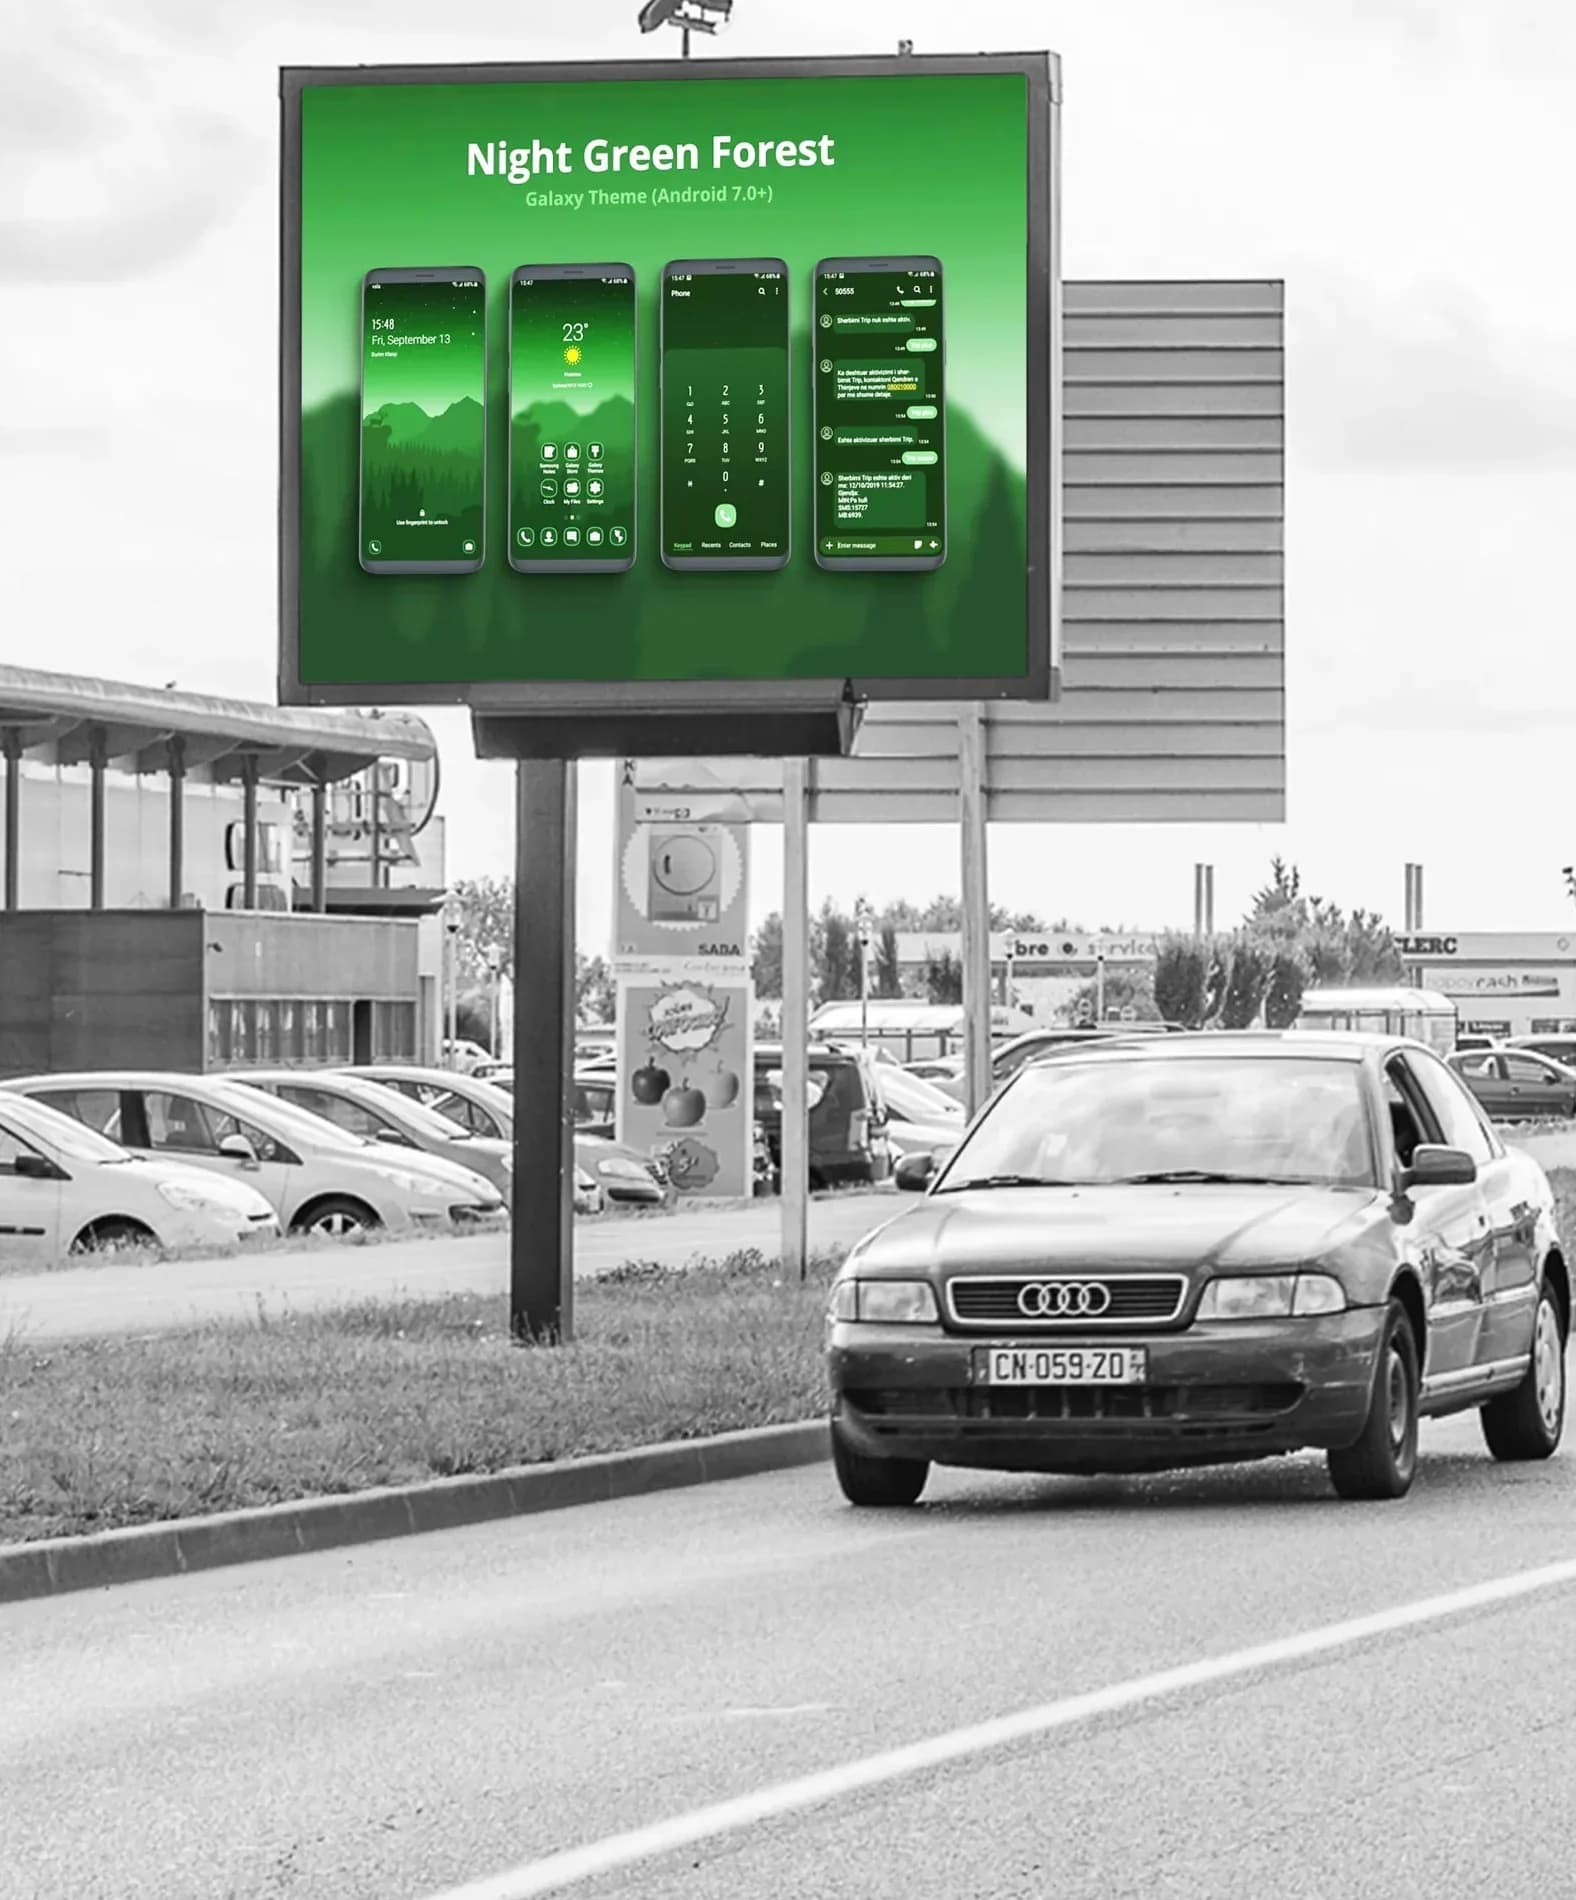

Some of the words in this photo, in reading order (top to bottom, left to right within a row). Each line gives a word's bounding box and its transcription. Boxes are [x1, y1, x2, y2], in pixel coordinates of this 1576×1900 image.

[467, 139, 572, 185] Night
[583, 138, 699, 173] Green
[712, 134, 835, 169] Forest
[525, 190, 584, 211] Galaxy
[588, 187, 648, 206] Theme
[651, 184, 728, 207] (Android
[731, 184, 774, 204] 7.0+)
[670, 289, 691, 298] Phone
[834, 287, 855, 296] 50555
[370, 318, 395, 331] 15:48
[861, 316, 871, 324] Trip
[561, 322, 589, 342] 23°
[371, 335, 386, 347] Fri,
[387, 334, 437, 348] September
[439, 333, 451, 345] 13
[687, 385, 693, 397] 1
[722, 384, 729, 397] 2
[758, 383, 765, 396] 3
[687, 413, 694, 426] 4
[722, 413, 729, 425] 5
[758, 412, 765, 425] 6
[687, 442, 694, 455] 7
[722, 442, 729, 454] 8
[758, 441, 765, 453] 9
[722, 471, 729, 483] 0
[862, 474, 872, 482] Trip
[849, 481, 880, 489] 12/10/2019
[395, 519, 405, 527] Use
[701, 541, 722, 549] Recents
[729, 541, 751, 549] Contacts
[760, 541, 778, 549] Places
[837, 542, 852, 550] Enter
[852, 543, 877, 551] message
